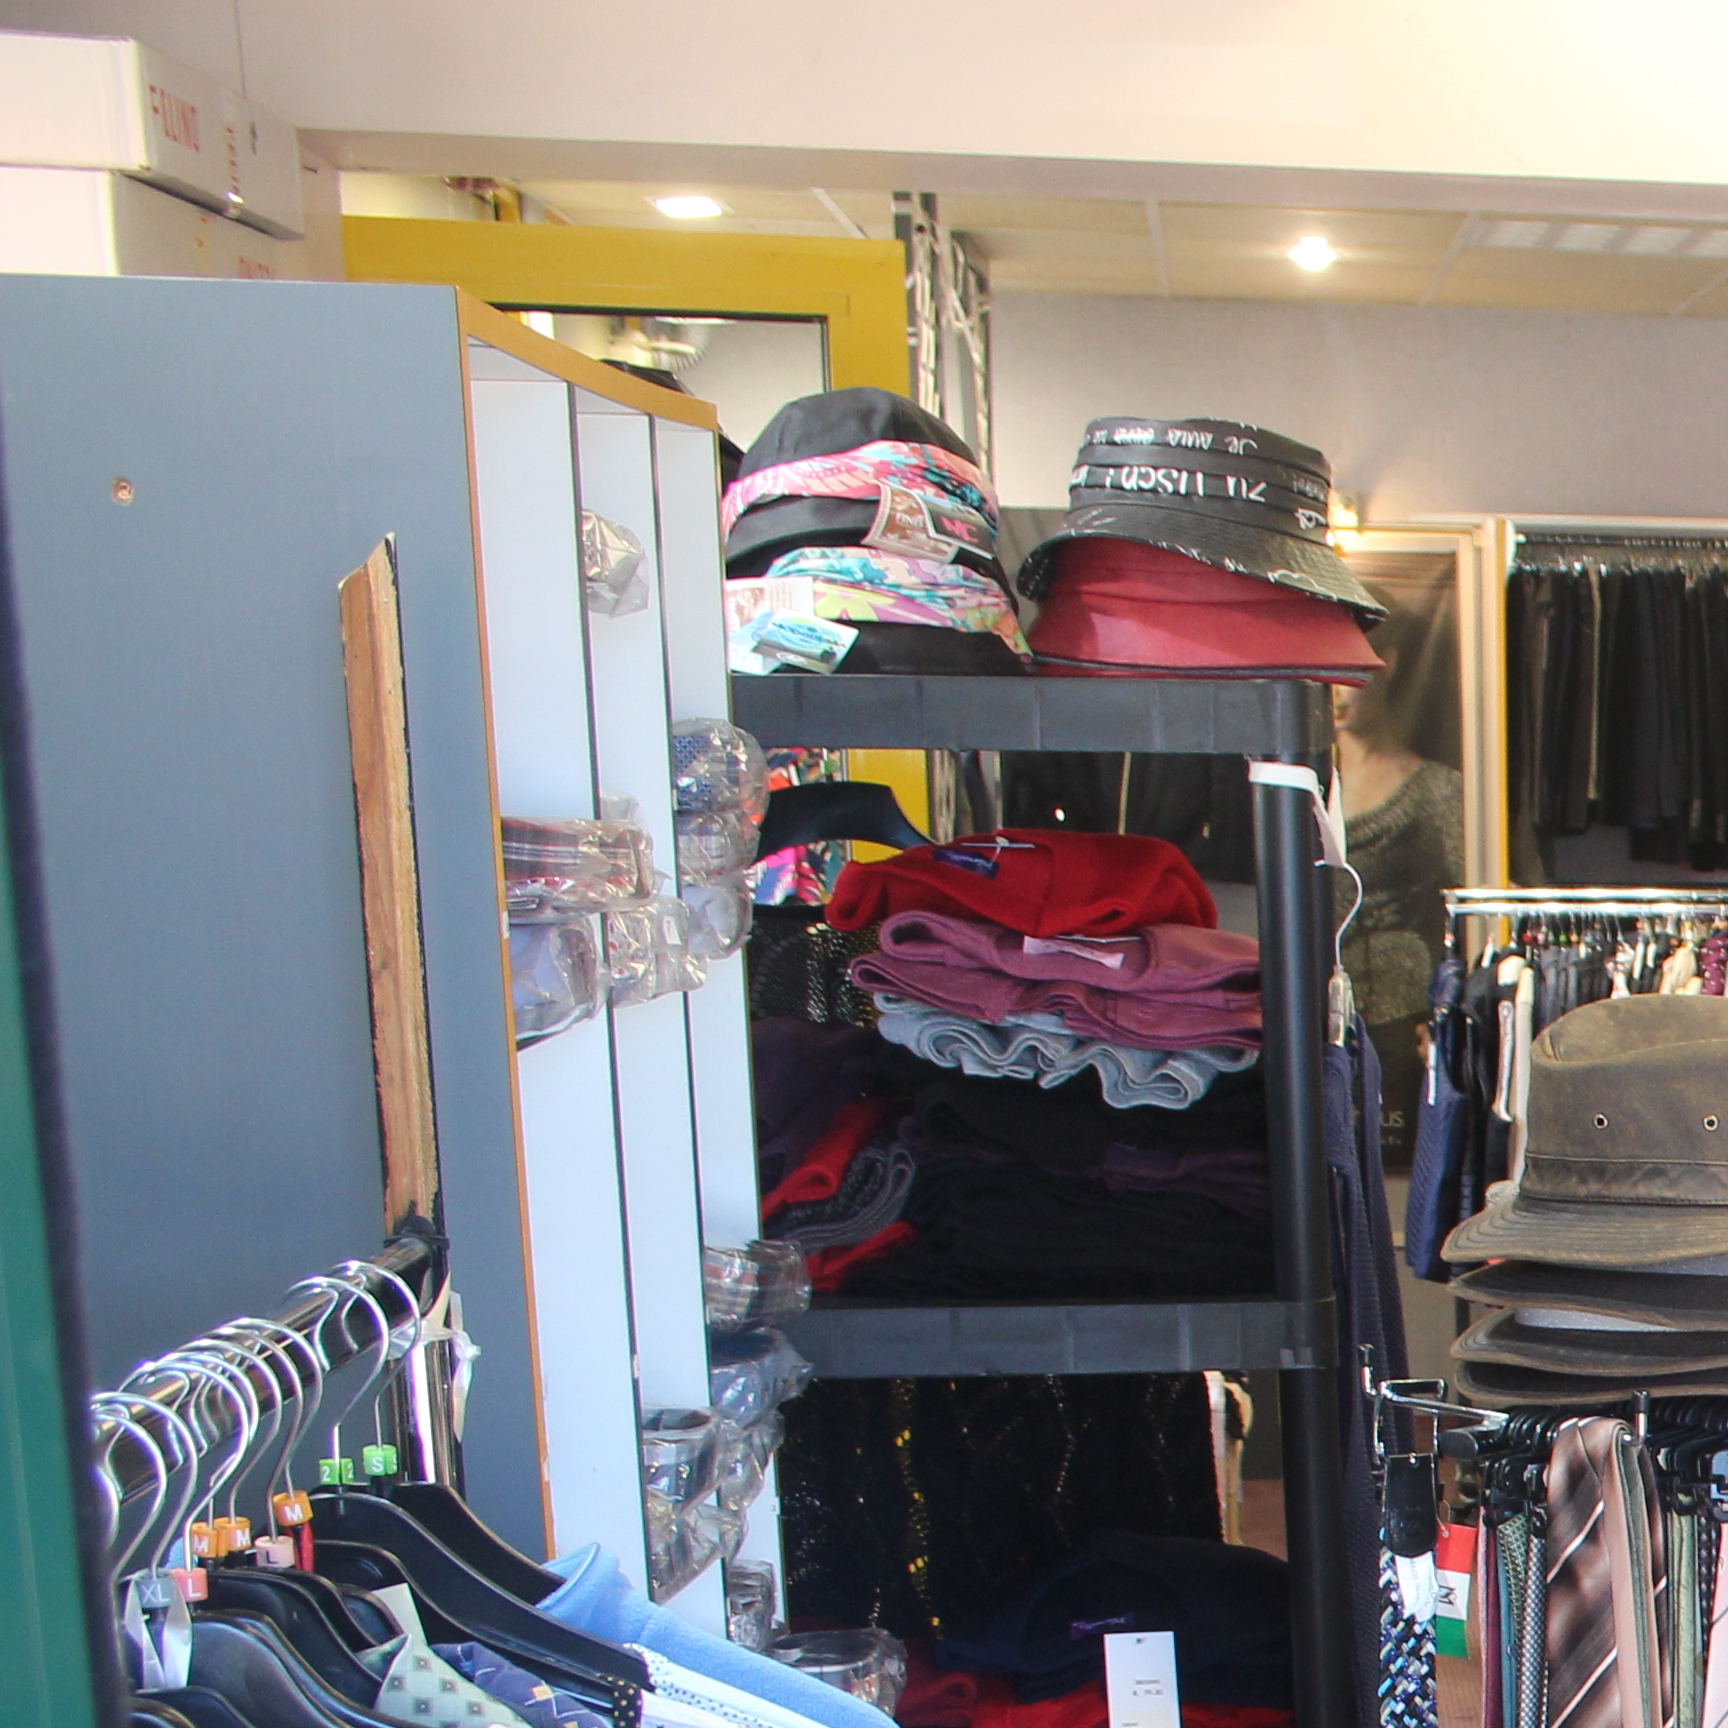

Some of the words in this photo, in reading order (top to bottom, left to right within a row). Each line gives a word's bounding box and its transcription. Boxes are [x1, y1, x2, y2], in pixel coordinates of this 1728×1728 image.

[374, 1456, 384, 1472] S
[322, 1465, 331, 1482] 2
[284, 1505, 303, 1521] M
[193, 1534, 208, 1553] M
[236, 1529, 251, 1547] M
[267, 1550, 278, 1564] L
[141, 1586, 170, 1604] XL
[188, 1578, 201, 1598] L
